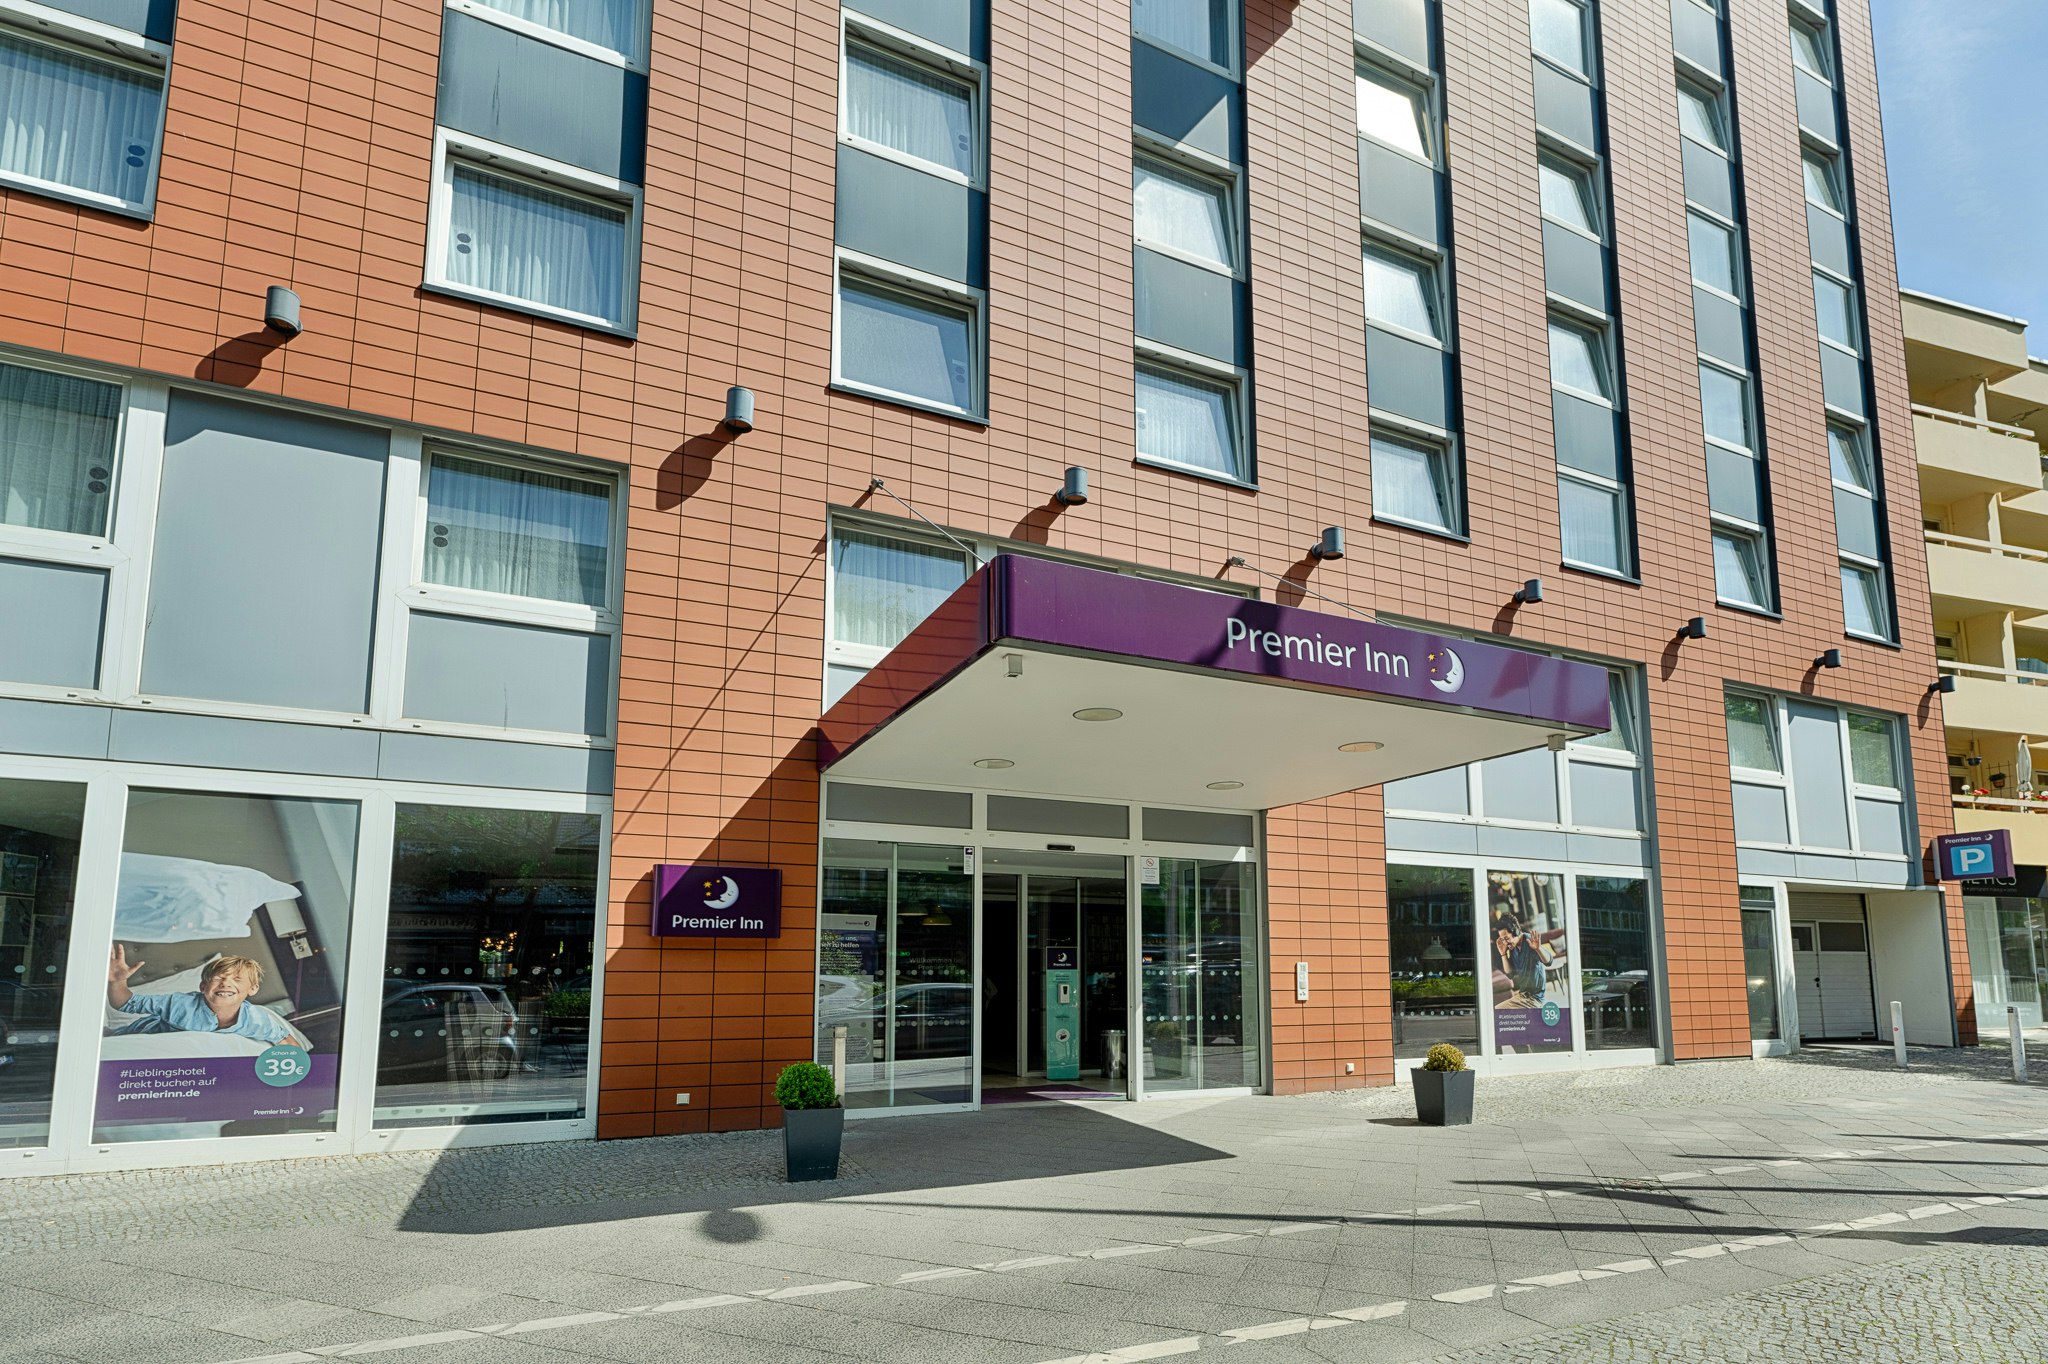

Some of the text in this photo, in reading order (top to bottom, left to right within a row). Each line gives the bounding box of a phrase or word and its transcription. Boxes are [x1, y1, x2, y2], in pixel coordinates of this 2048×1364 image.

[1227, 617, 1410, 678] Premier Inn
[1960, 848, 1985, 872] P
[672, 914, 764, 929] Premier Inn
[1544, 1010, 1559, 1020] 39€
[119, 1067, 206, 1079] #Lieblingshotel
[263, 1058, 304, 1076] 39€
[119, 1077, 217, 1089] direkt buchen auf
[117, 1089, 201, 1102] premierinn.de
